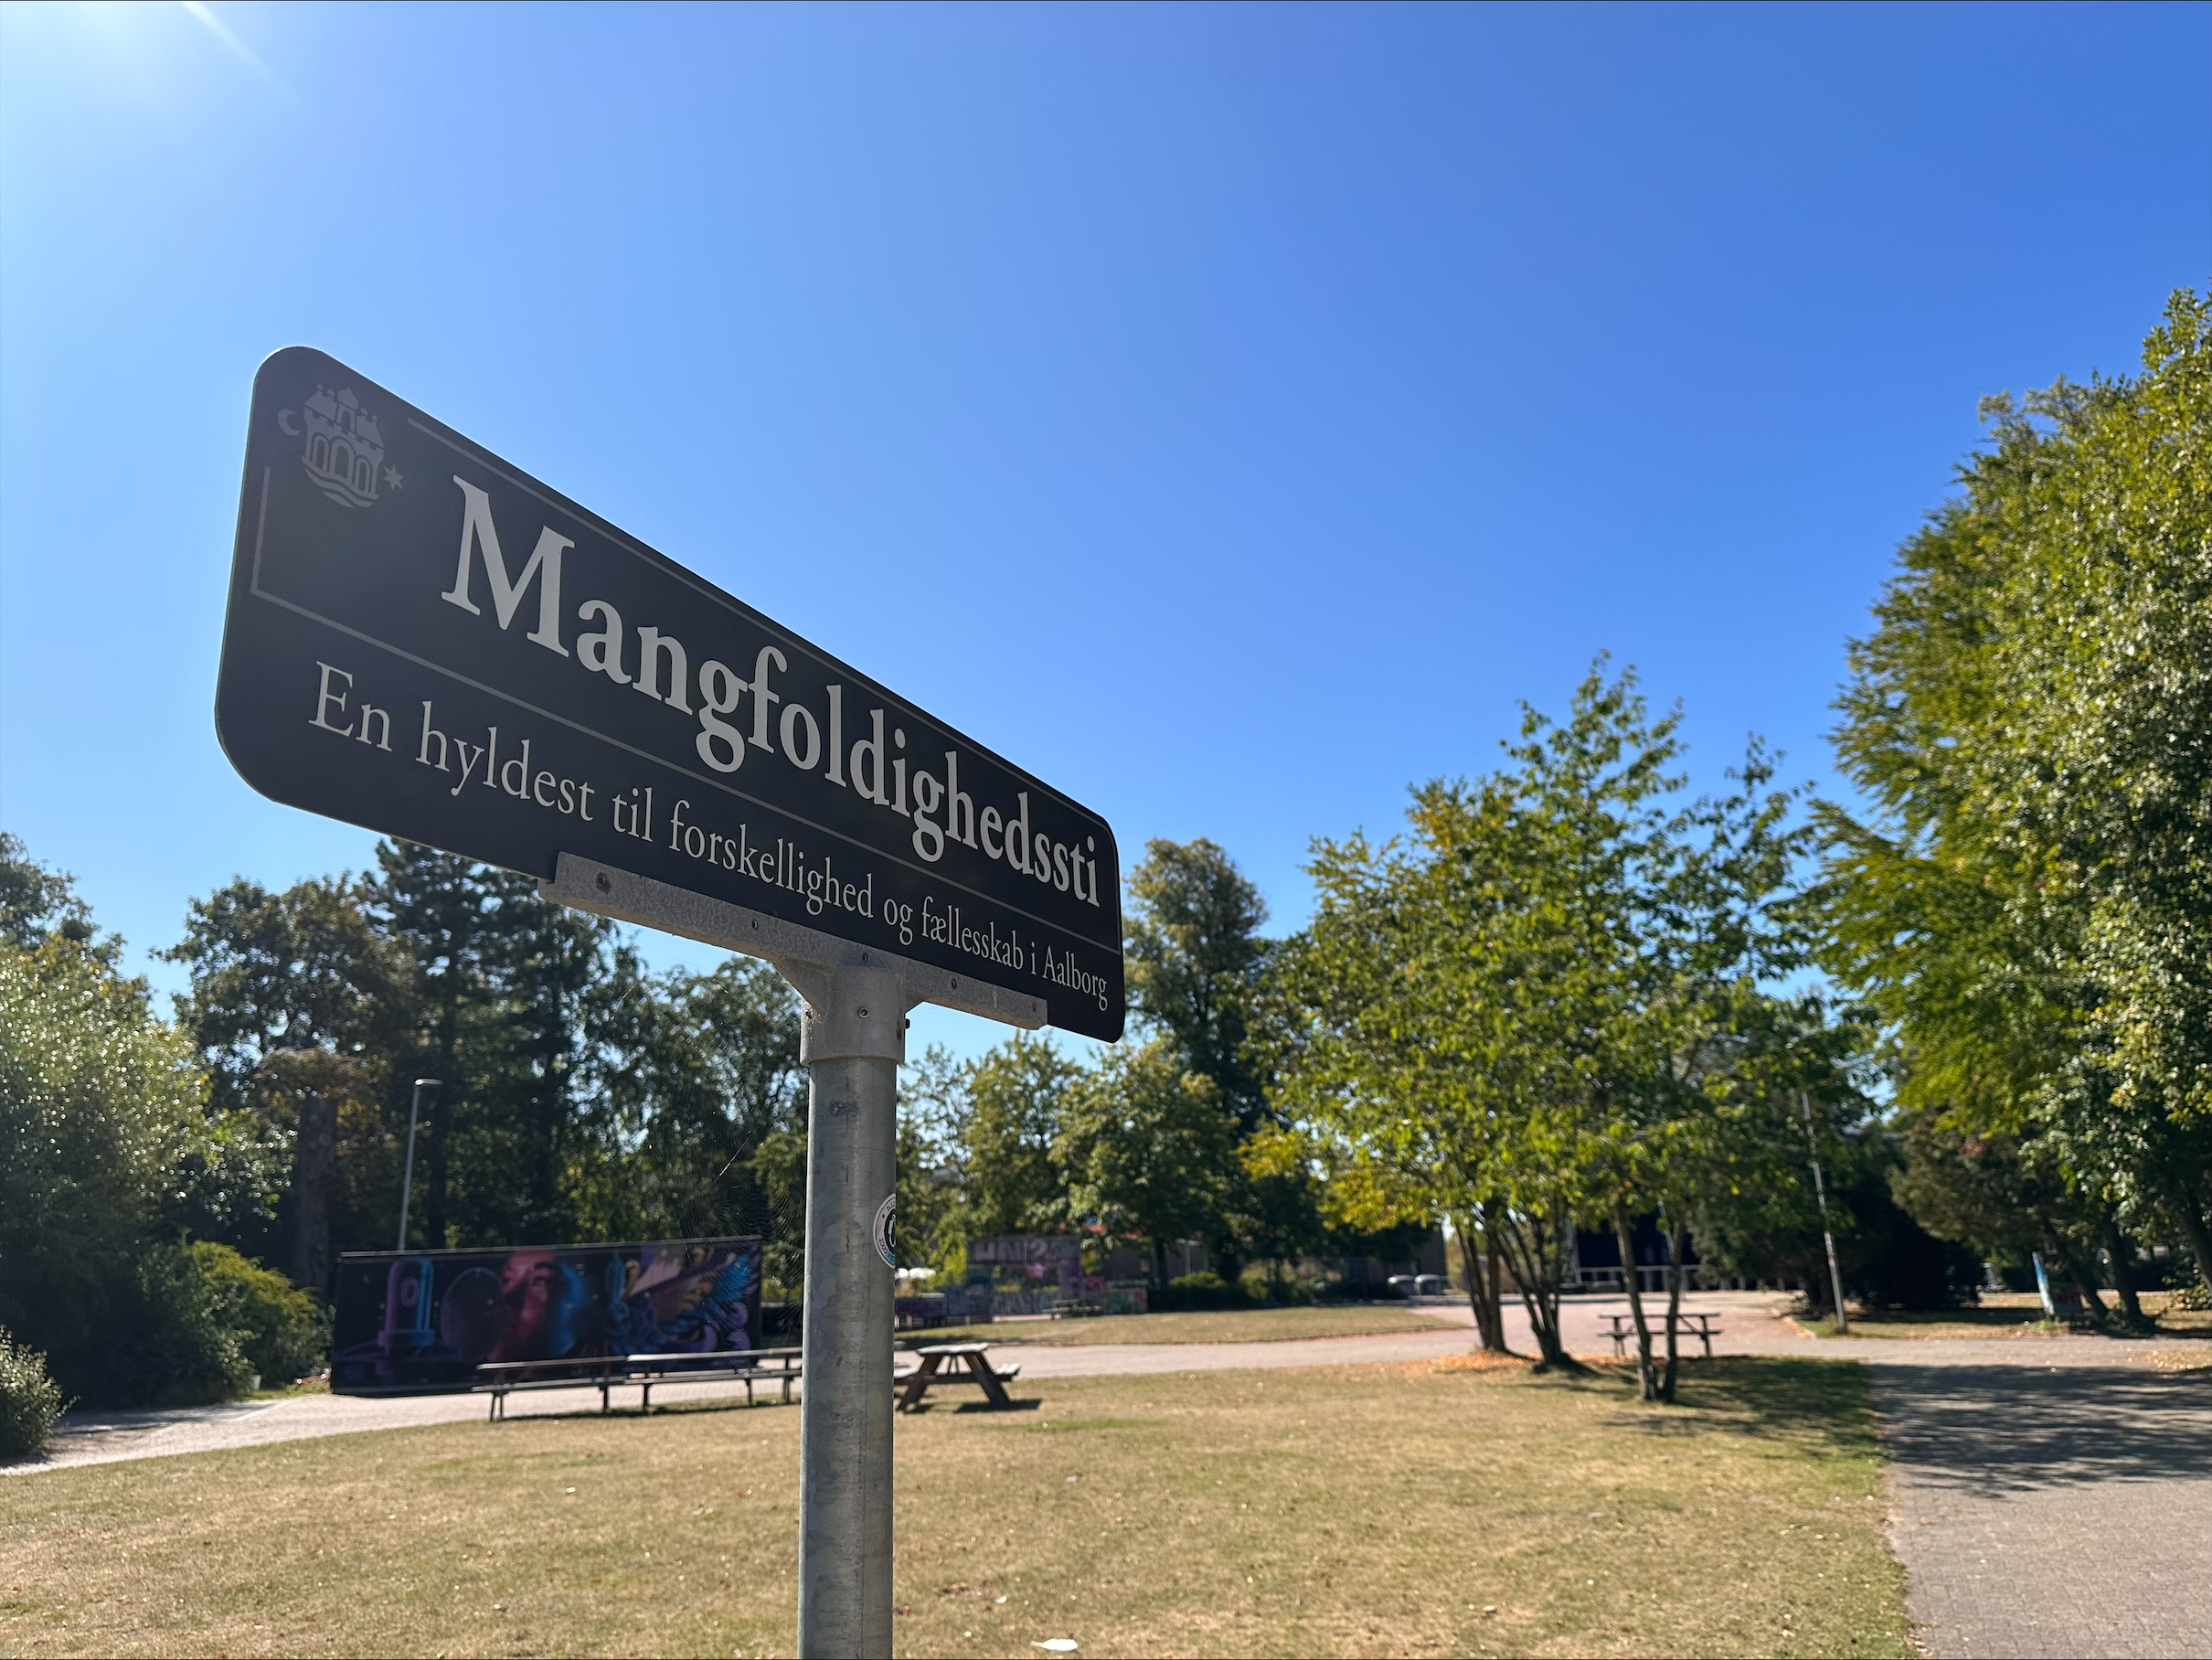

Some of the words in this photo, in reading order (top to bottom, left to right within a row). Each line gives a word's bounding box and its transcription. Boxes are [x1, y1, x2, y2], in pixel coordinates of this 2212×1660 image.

[308, 660, 393, 752] En
[415, 700, 595, 822] hyldest
[612, 786, 654, 843] til
[668, 799, 874, 919] forskellighed
[883, 899, 914, 946] og
[921, 896, 1024, 970] fællesskab
[1031, 942, 1037, 975] i
[1042, 946, 1108, 1011] Aalborg
[441, 474, 1100, 908] Mangfoldighedssti
